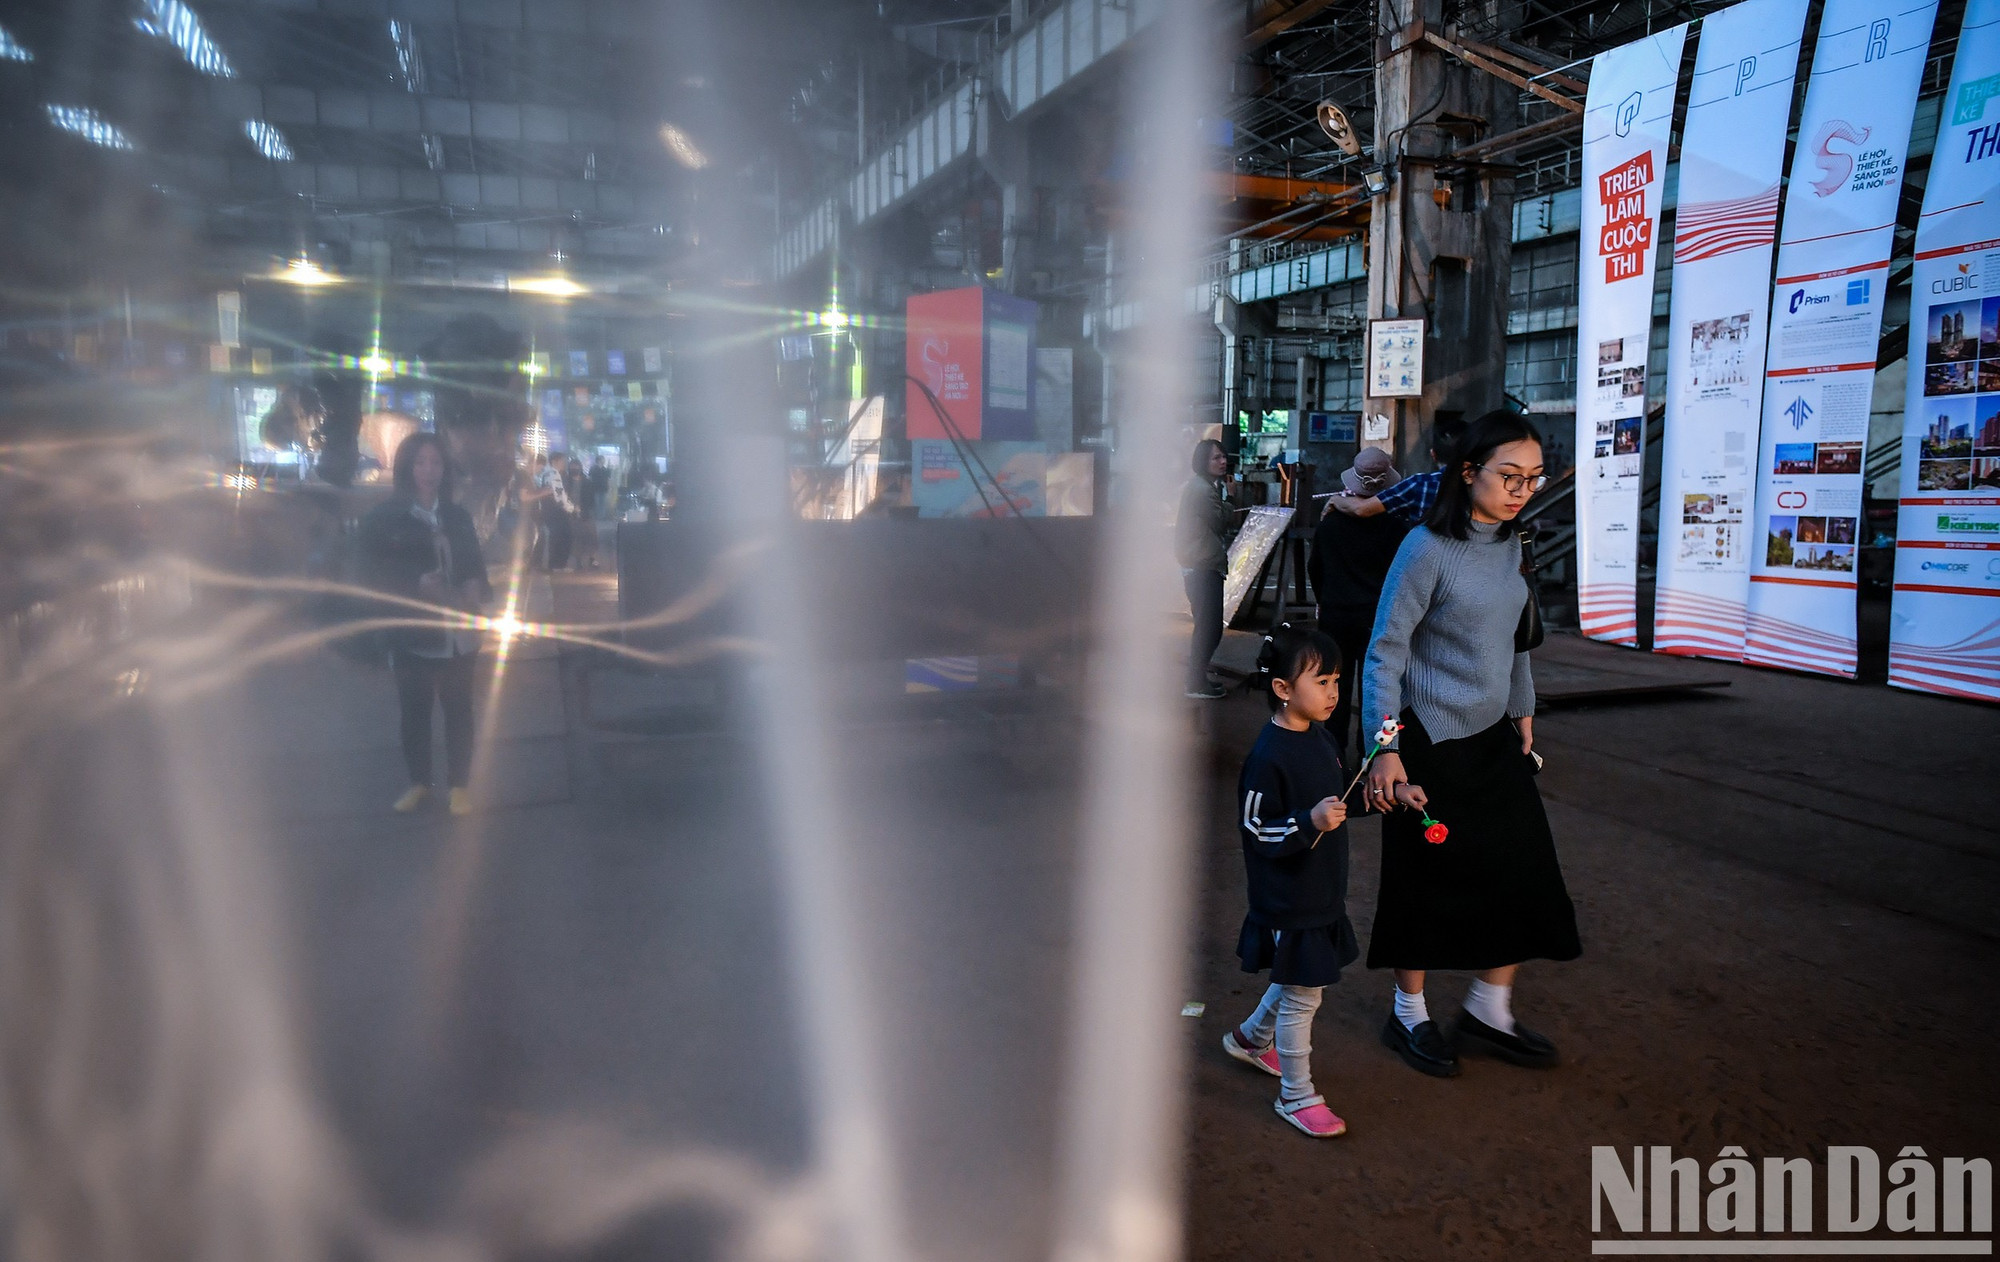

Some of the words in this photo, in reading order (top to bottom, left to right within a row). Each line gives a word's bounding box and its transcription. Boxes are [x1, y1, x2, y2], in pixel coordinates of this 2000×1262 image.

[1865, 18, 1891, 63] R
[1965, 122, 2000, 164] TH
[1604, 159, 1648, 197] TRIỂN
[1609, 194, 1642, 224] LÃM
[1603, 221, 1648, 252] CUỘC
[1612, 252, 1637, 278] THI
[1932, 274, 1979, 295] CUBIC
[1804, 294, 1830, 306] Prism
